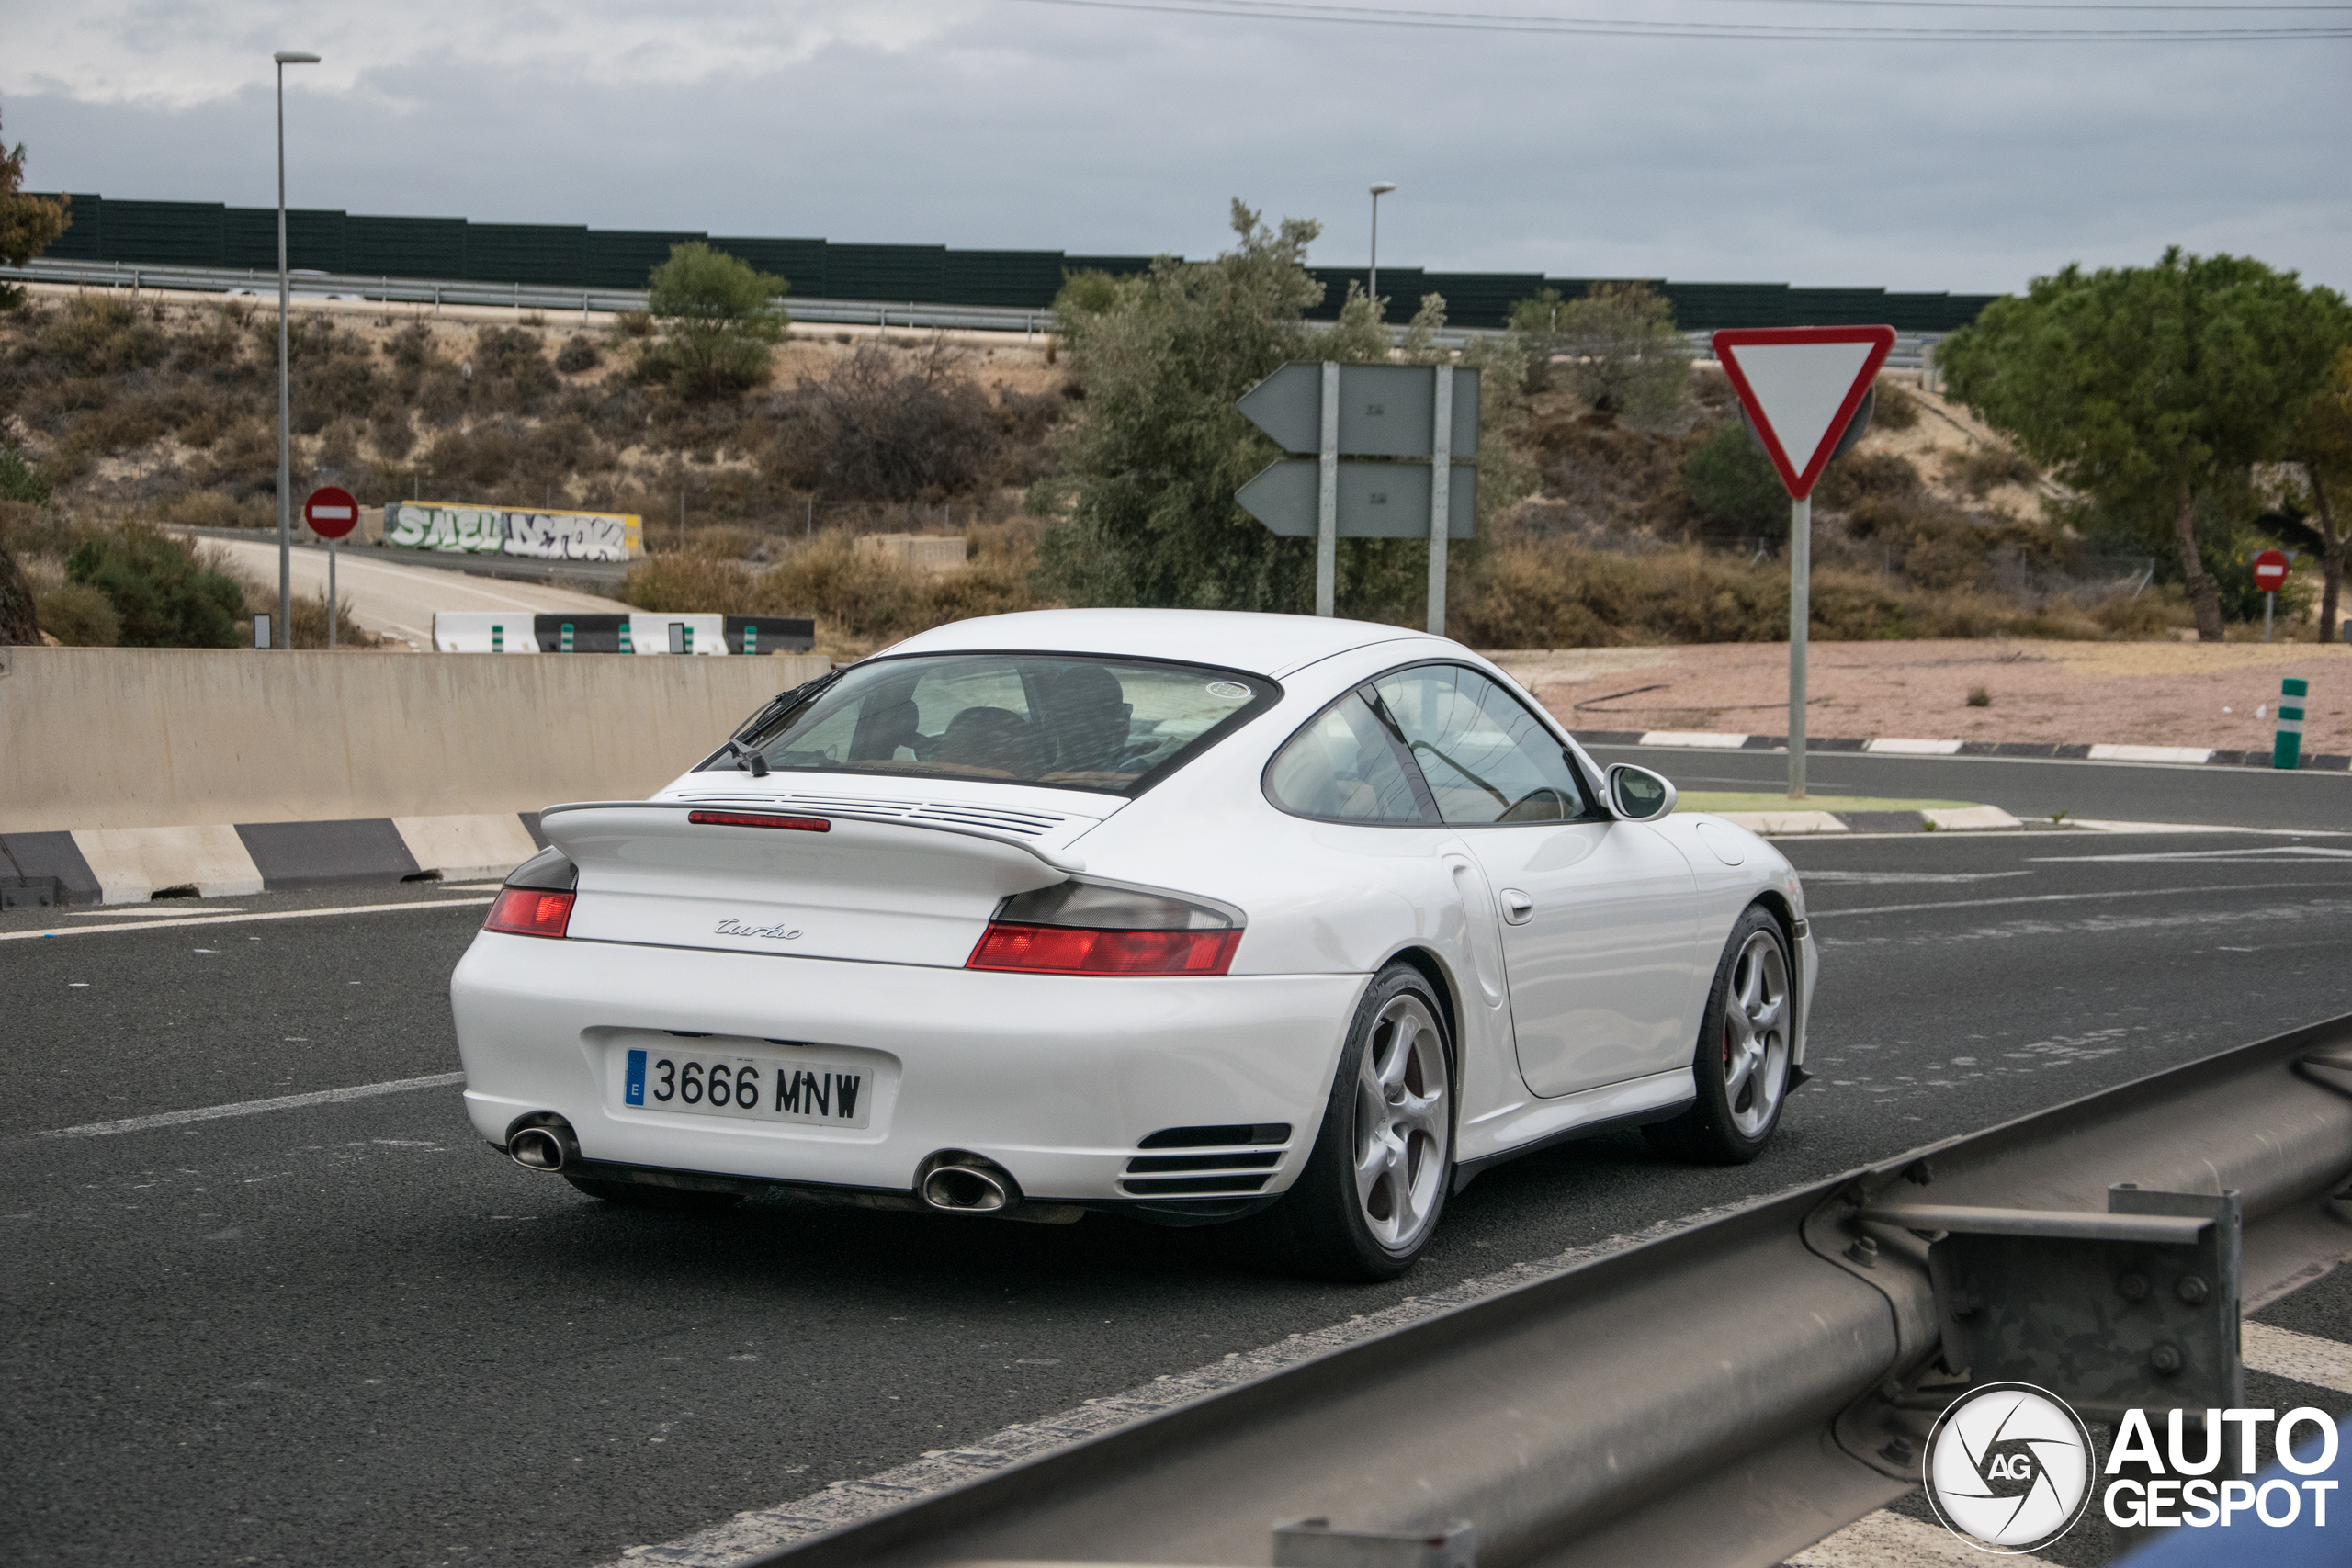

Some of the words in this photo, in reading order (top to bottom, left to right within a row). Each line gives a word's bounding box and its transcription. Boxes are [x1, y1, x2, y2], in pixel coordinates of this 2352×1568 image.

[714, 918, 803, 940] turbo
[631, 1083, 639, 1096] E
[653, 1059, 760, 1109] 3666
[775, 1068, 861, 1119] MNW
